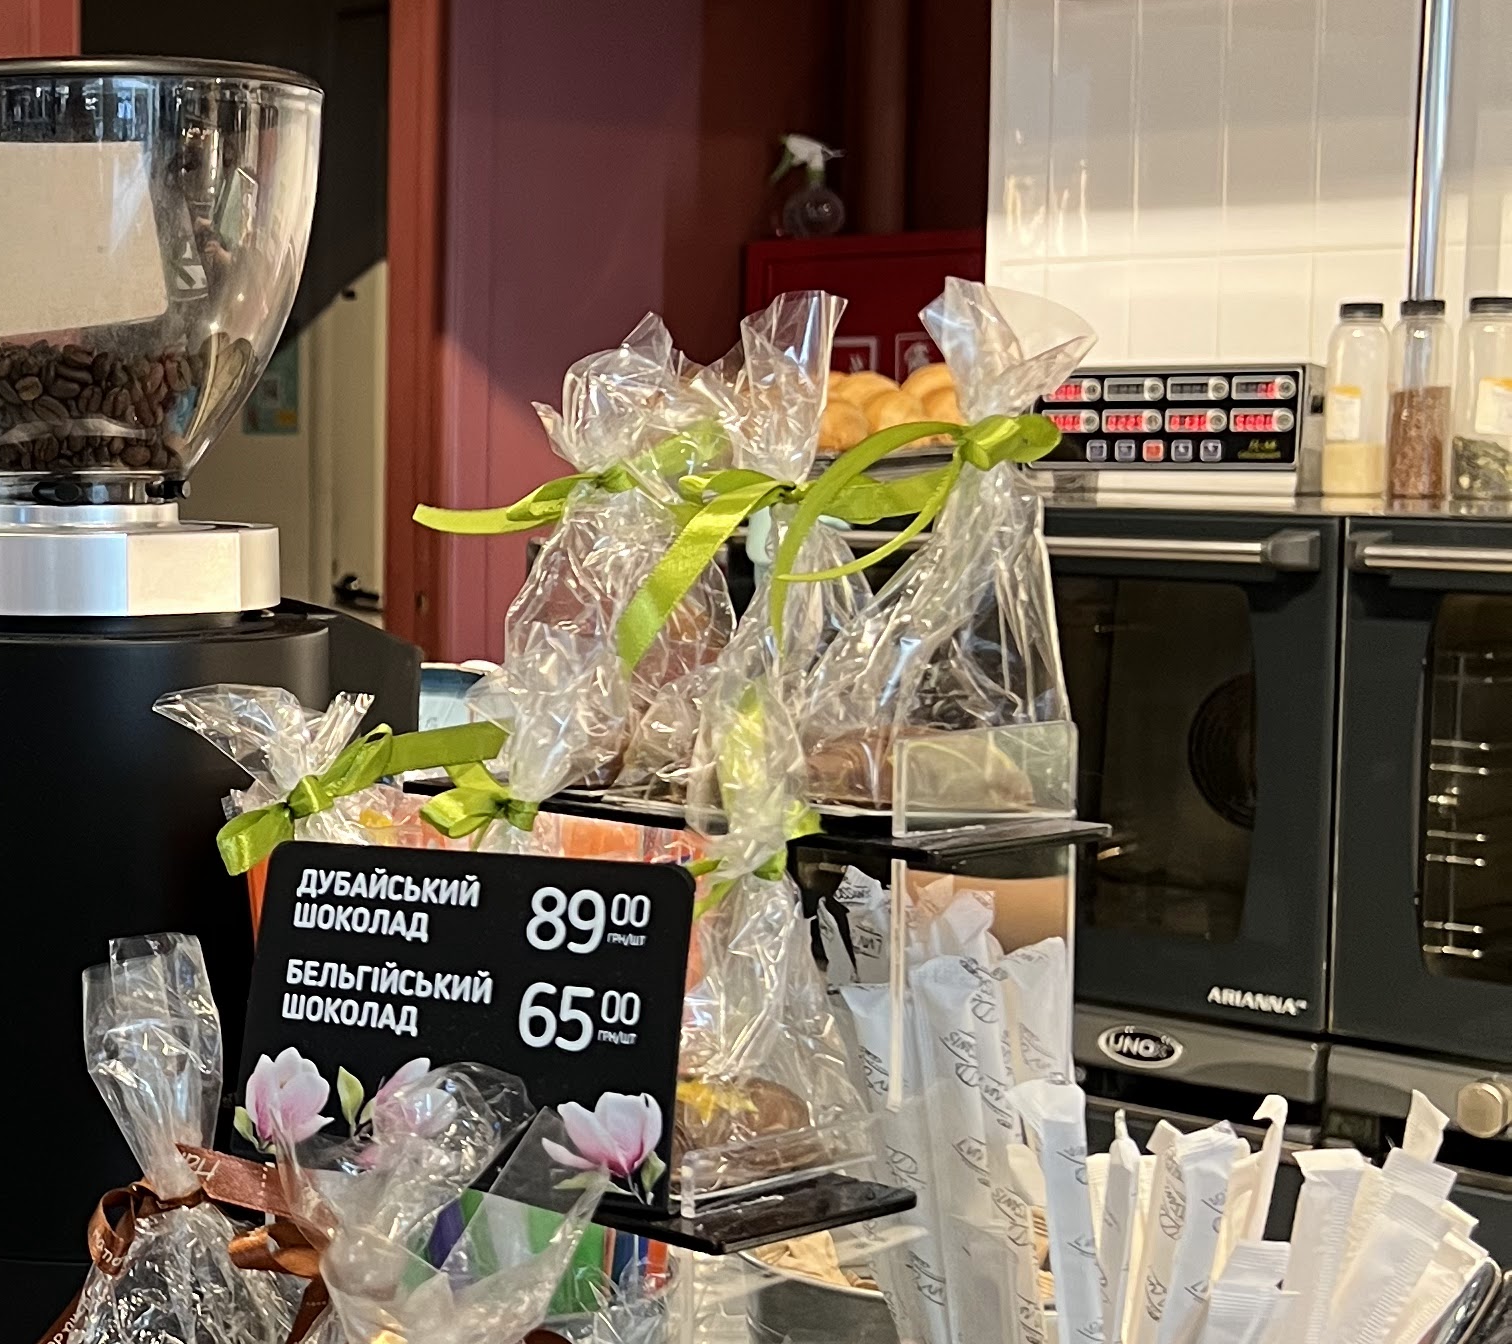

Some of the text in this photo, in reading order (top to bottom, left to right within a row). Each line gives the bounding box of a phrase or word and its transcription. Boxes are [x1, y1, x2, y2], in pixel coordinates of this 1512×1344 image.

[296, 868, 481, 907] ДУБАЙСЬКИЙ
[293, 903, 429, 943] ШОКОЛАД
[286, 958, 494, 1005] БЕЛЬГІЙСЬКИЙ
[282, 992, 419, 1037] ШОКОЛАД
